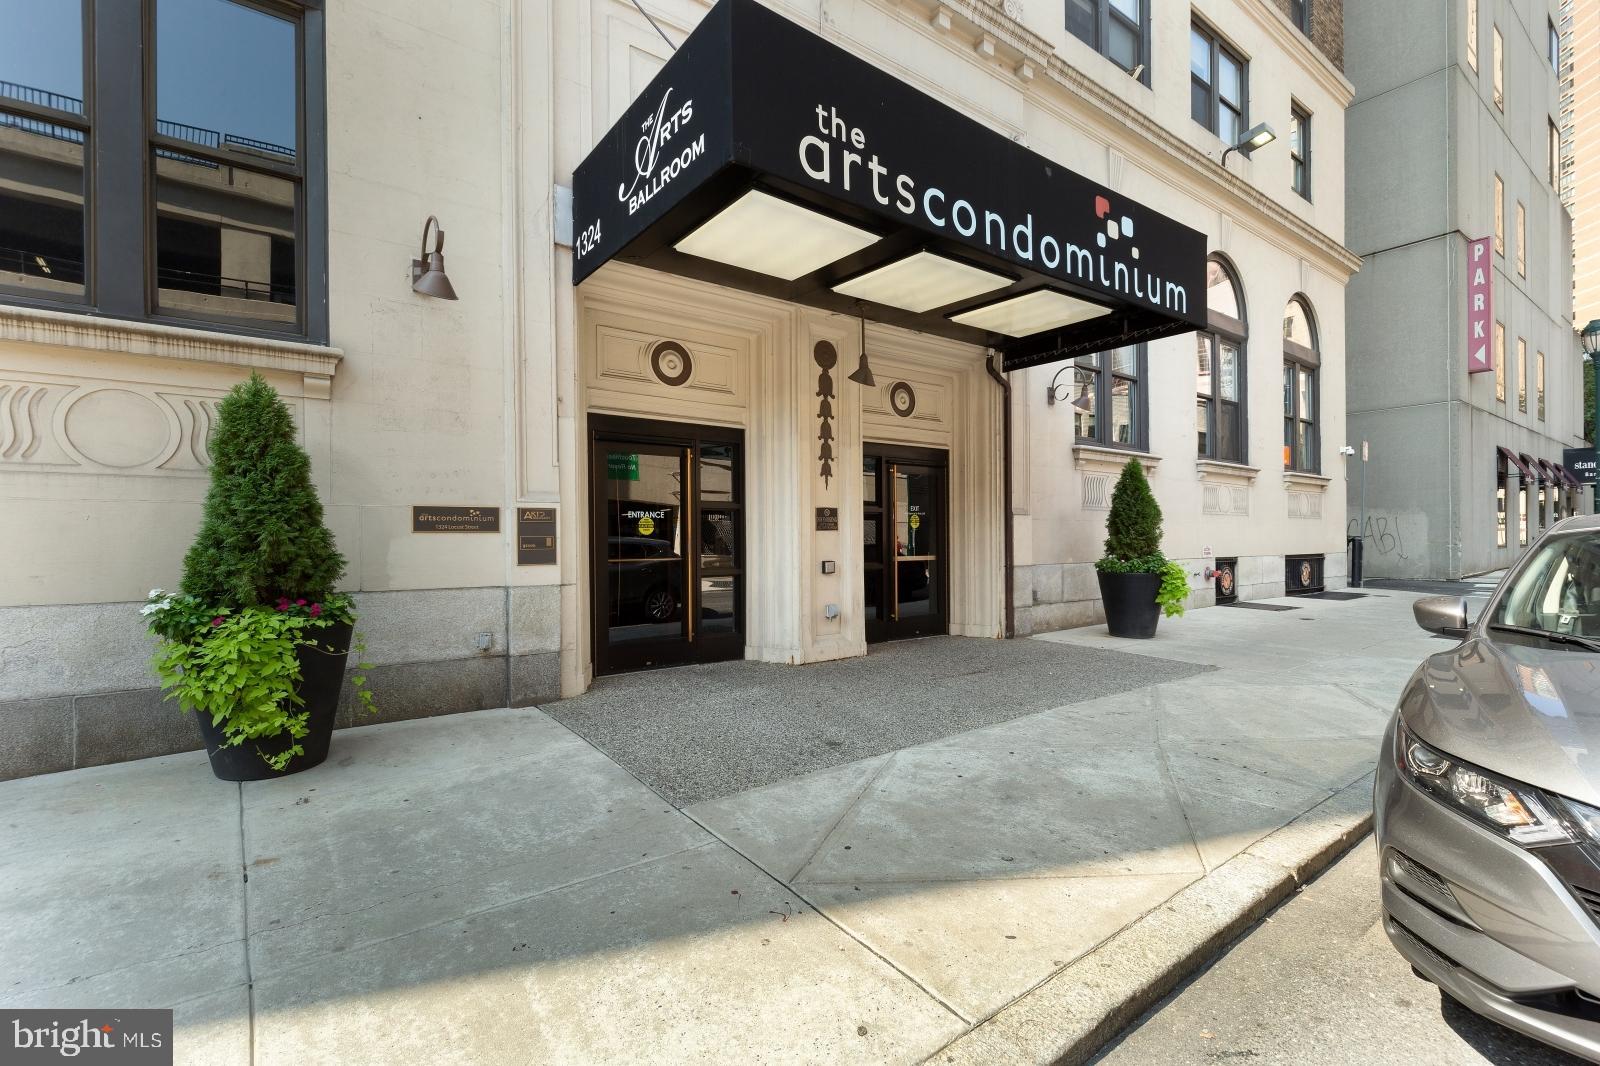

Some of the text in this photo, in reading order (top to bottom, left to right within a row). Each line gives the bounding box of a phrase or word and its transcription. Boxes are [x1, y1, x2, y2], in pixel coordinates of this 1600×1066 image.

[641, 113, 654, 133] THE
[815, 104, 866, 149] the
[629, 133, 705, 216] BALLROOM
[575, 218, 602, 260] 1324
[1473, 243, 1486, 339] PARK
[628, 511, 665, 519] ENTRANCE
